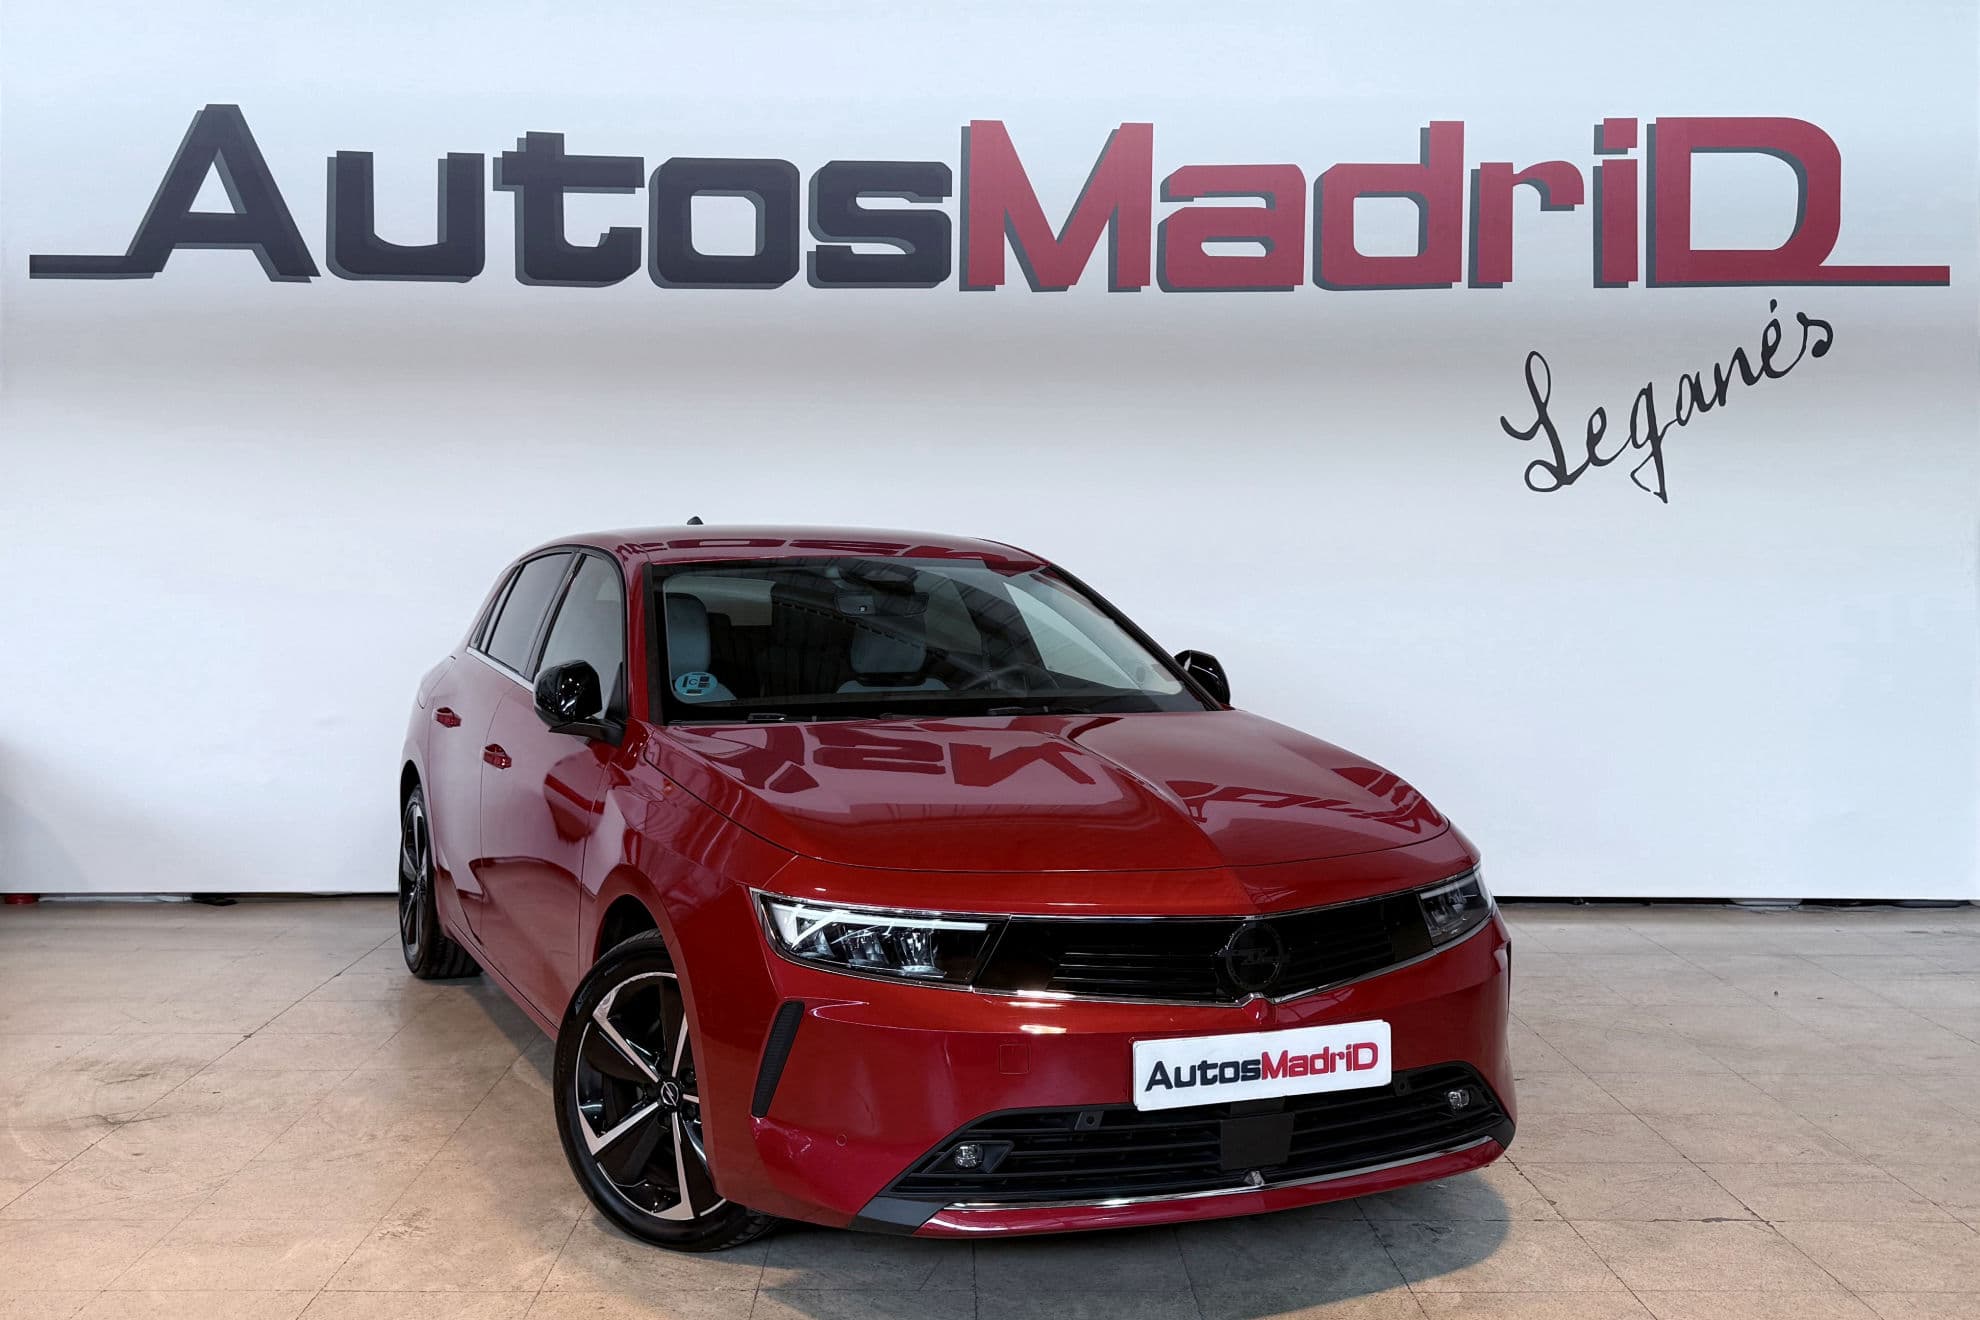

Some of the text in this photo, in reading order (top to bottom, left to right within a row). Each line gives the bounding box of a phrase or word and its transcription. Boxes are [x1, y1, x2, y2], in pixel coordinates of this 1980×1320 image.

[29, 103, 1950, 293] AutosMadriD
[1500, 299, 1834, 504] Leganés
[1144, 1041, 1379, 1092] AutosMadriD
